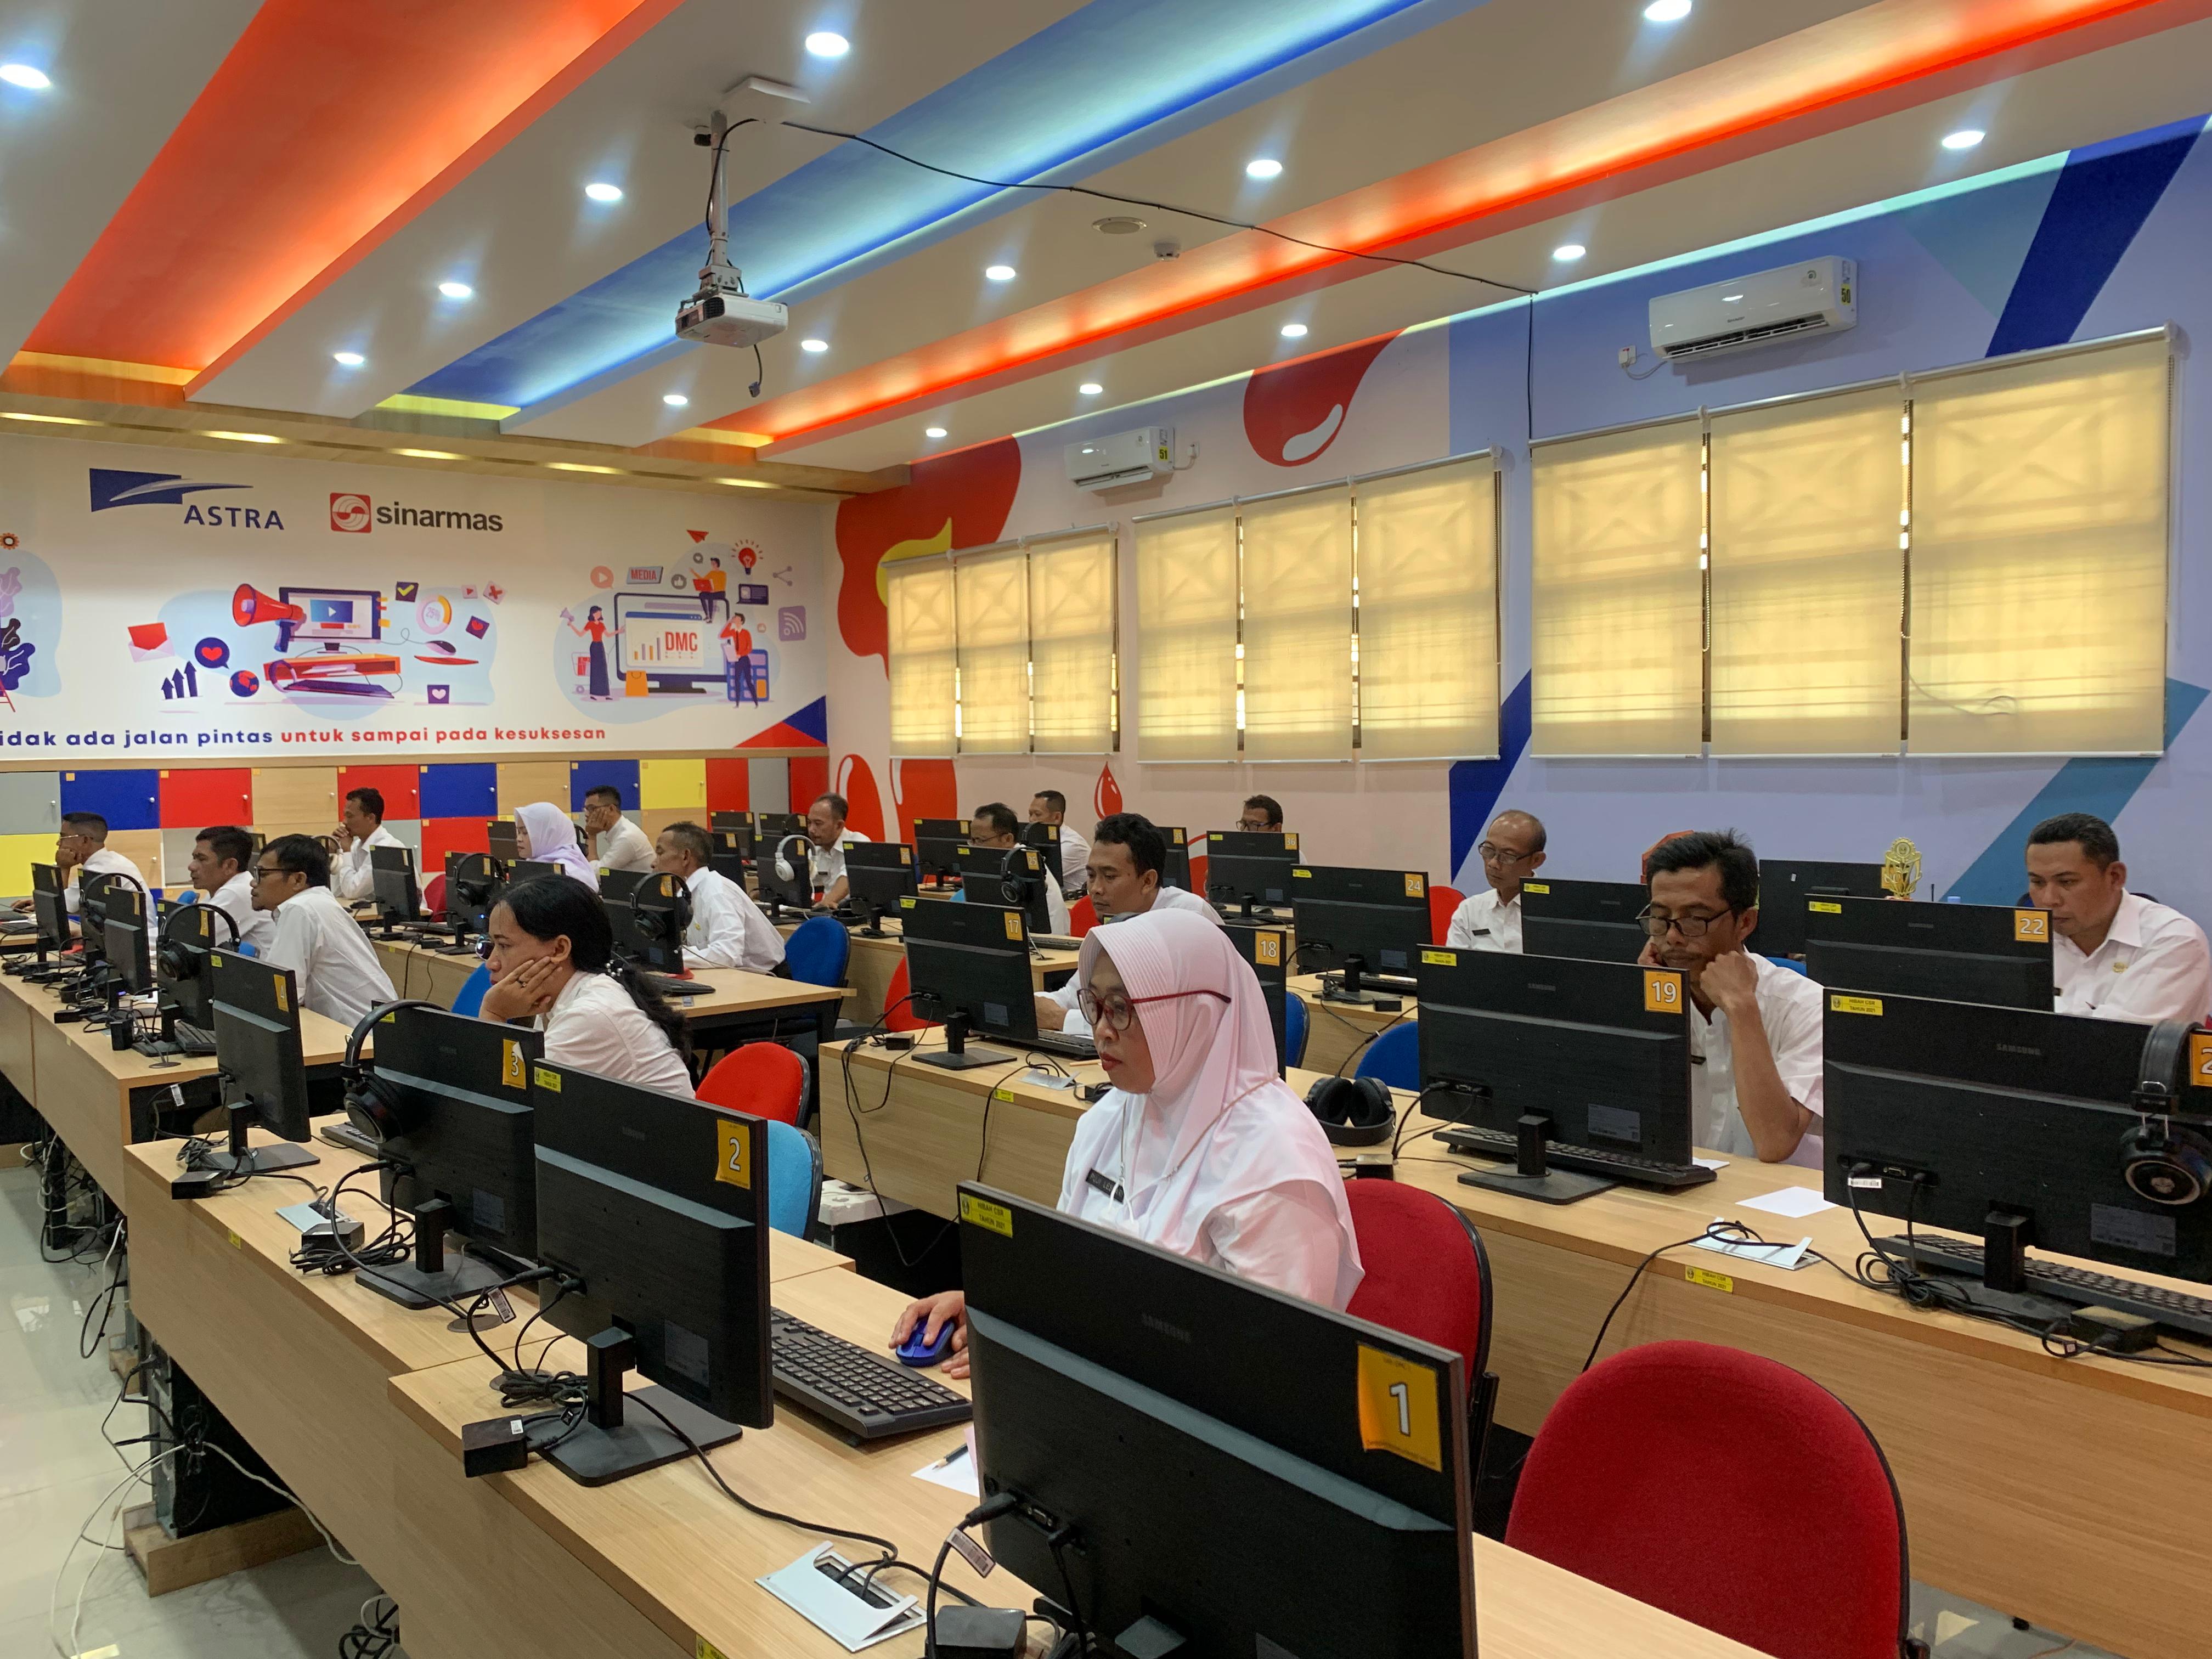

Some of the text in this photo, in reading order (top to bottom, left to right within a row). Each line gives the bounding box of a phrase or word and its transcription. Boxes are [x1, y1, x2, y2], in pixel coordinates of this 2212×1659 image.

[1159, 449, 1168, 460] 51
[184, 504, 284, 531] ASTRA
[376, 501, 503, 532] sinarmas
[630, 569, 657, 580] MEDIA
[664, 631, 698, 652] DMC
[66, 731, 115, 746] ada
[124, 730, 188, 748] jalan
[198, 729, 273, 747] pintas
[281, 729, 343, 742] untuk
[351, 727, 428, 744] sampai
[436, 727, 487, 743] pada
[495, 727, 606, 740] kesuksesan
[1407, 879, 1421, 891] 24
[1008, 919, 1019, 934] 17
[2019, 917, 2045, 935] 22
[1260, 939, 1277, 958] 18
[1651, 980, 1677, 1004] 19
[511, 1051, 519, 1077] 3
[729, 1137, 741, 1172] 2
[1389, 1381, 1411, 1437] 1
